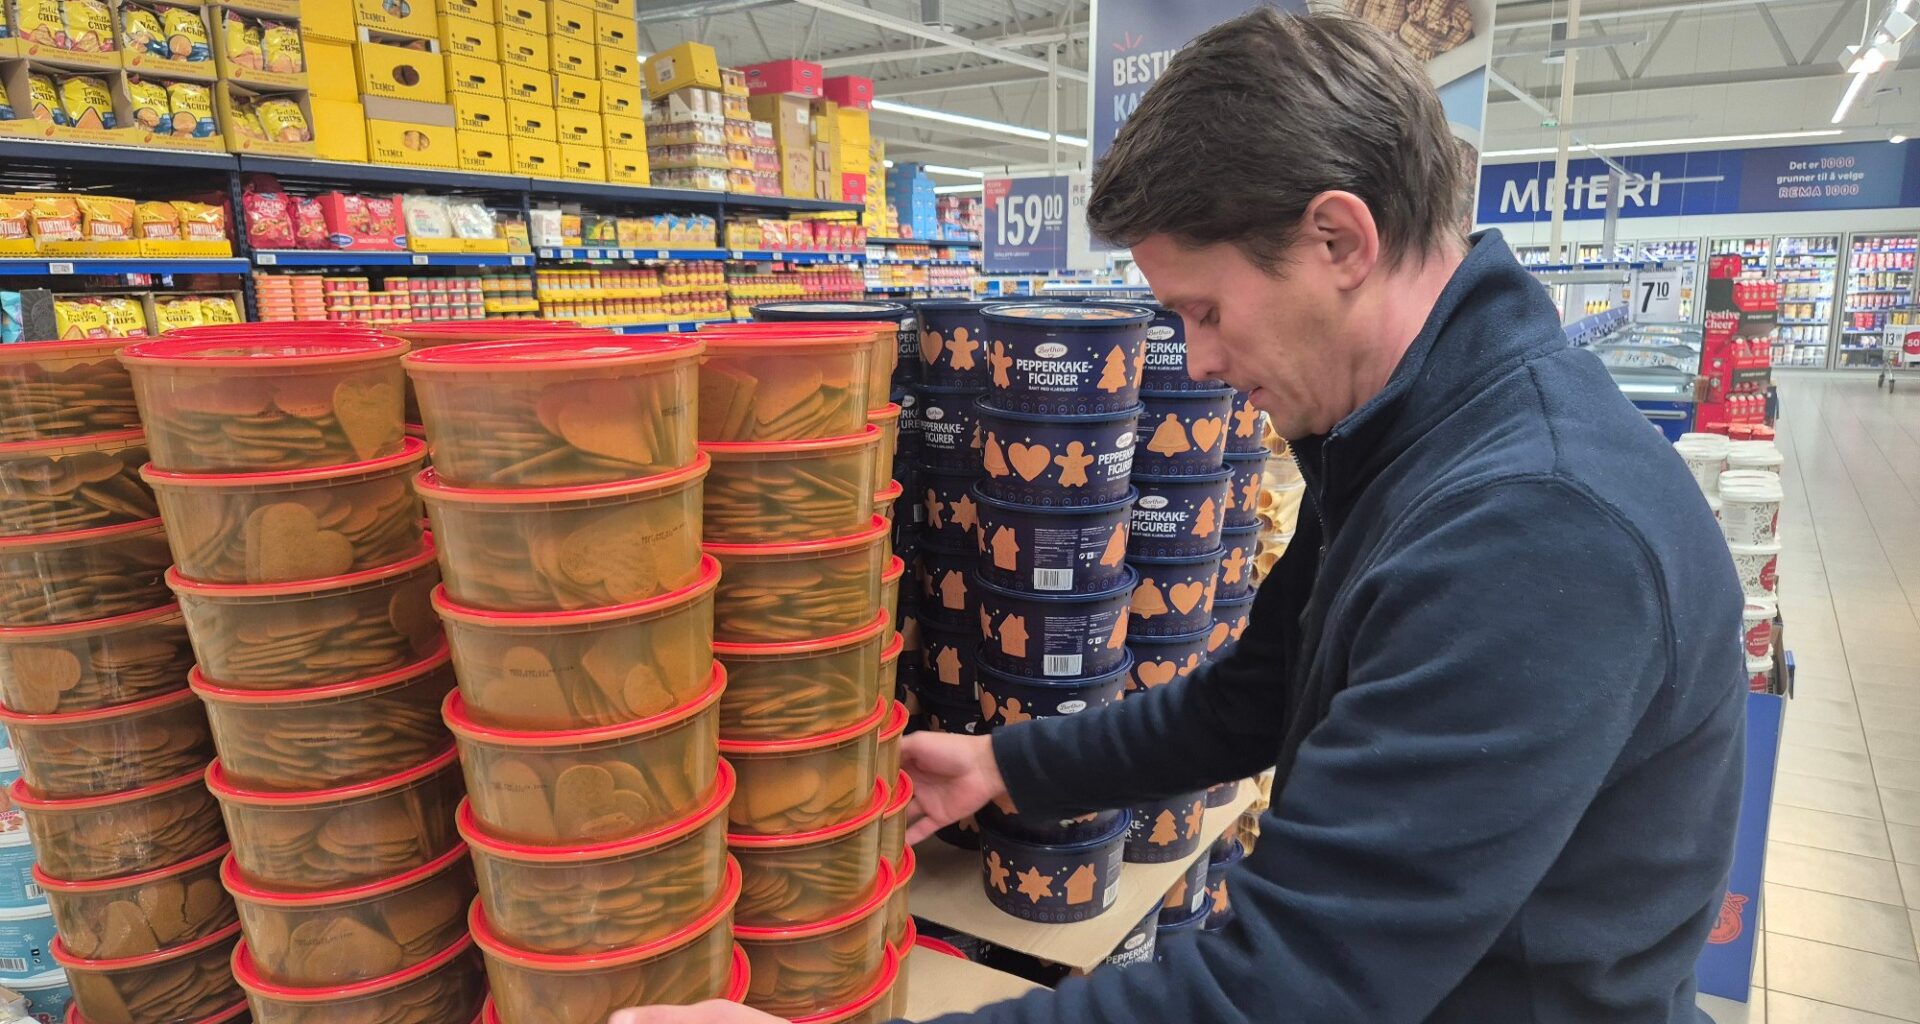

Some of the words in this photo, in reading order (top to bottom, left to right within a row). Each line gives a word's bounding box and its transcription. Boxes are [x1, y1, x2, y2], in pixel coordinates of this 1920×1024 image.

[1113, 49, 1176, 86] BESTI
[1789, 161, 1806, 171] Det
[1820, 157, 1855, 169] 1000
[1776, 174, 1815, 185] grunner
[1817, 172, 1827, 181] til
[1837, 171, 1865, 181] velge
[1778, 186, 1822, 198] REMA
[1825, 184, 1859, 196] 1000
[995, 194, 1042, 246] 159
[1641, 282, 1655, 313] 7
[1657, 281, 1669, 297] 10
[1705, 309, 1740, 320] Festive
[1704, 320, 1734, 329] Cheer
[1016, 359, 1093, 373] PEPPERKAKE-
[1028, 373, 1079, 386] FIGURER
[1132, 521, 1177, 533] FIGURER
